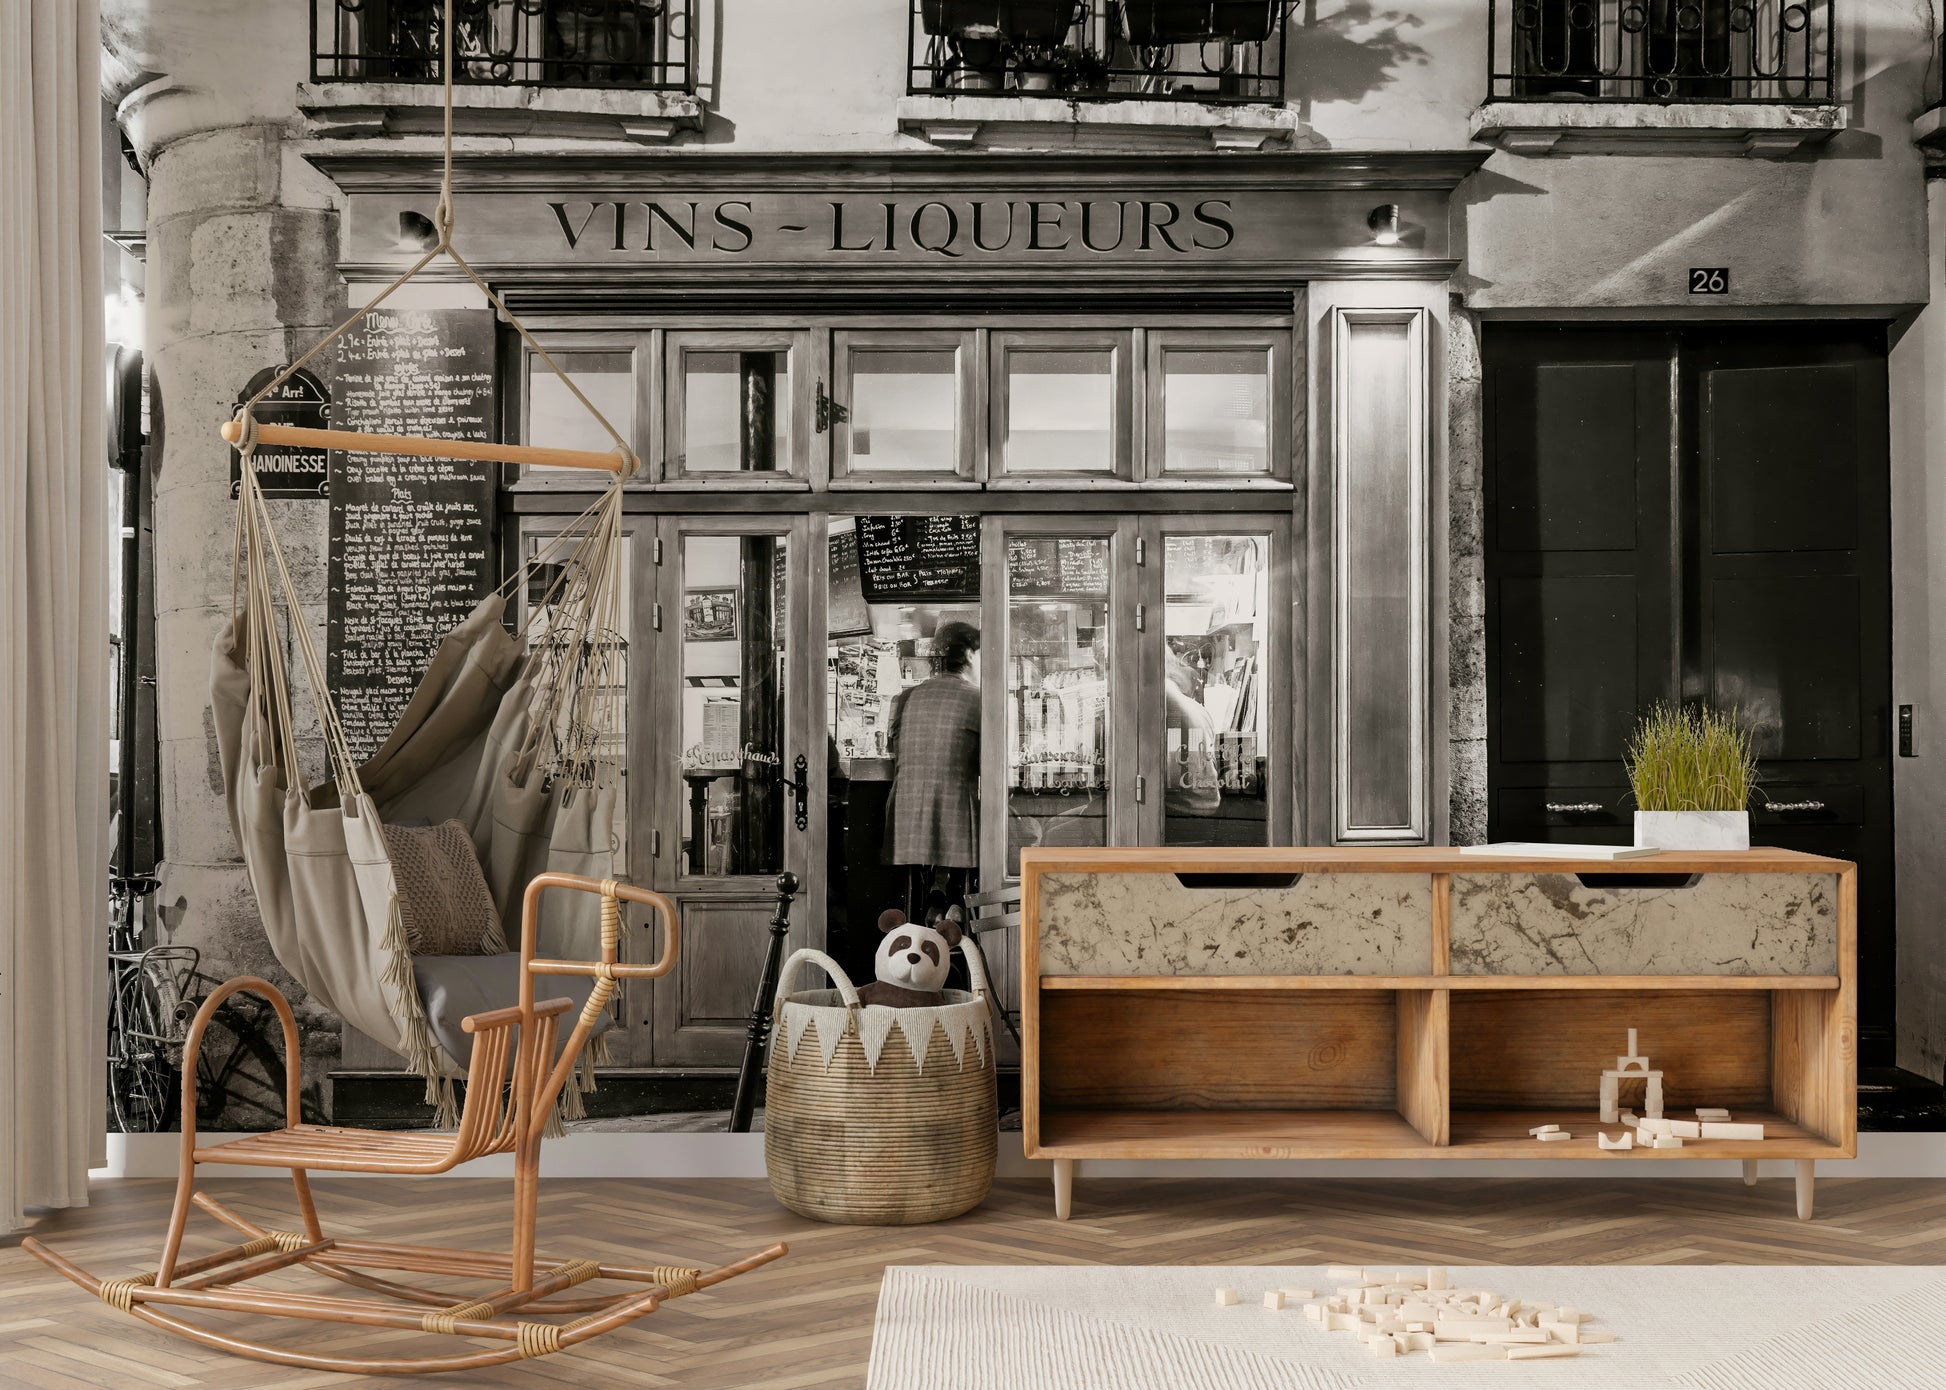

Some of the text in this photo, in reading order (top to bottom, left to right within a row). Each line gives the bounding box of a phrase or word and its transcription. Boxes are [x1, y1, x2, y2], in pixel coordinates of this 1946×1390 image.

[547, 201, 753, 253] VINS
[828, 199, 1236, 258] LIQUEURS
[1693, 270, 1724, 292] 26
[240, 454, 326, 473] HANOINESSE
[390, 487, 412, 500] Plats
